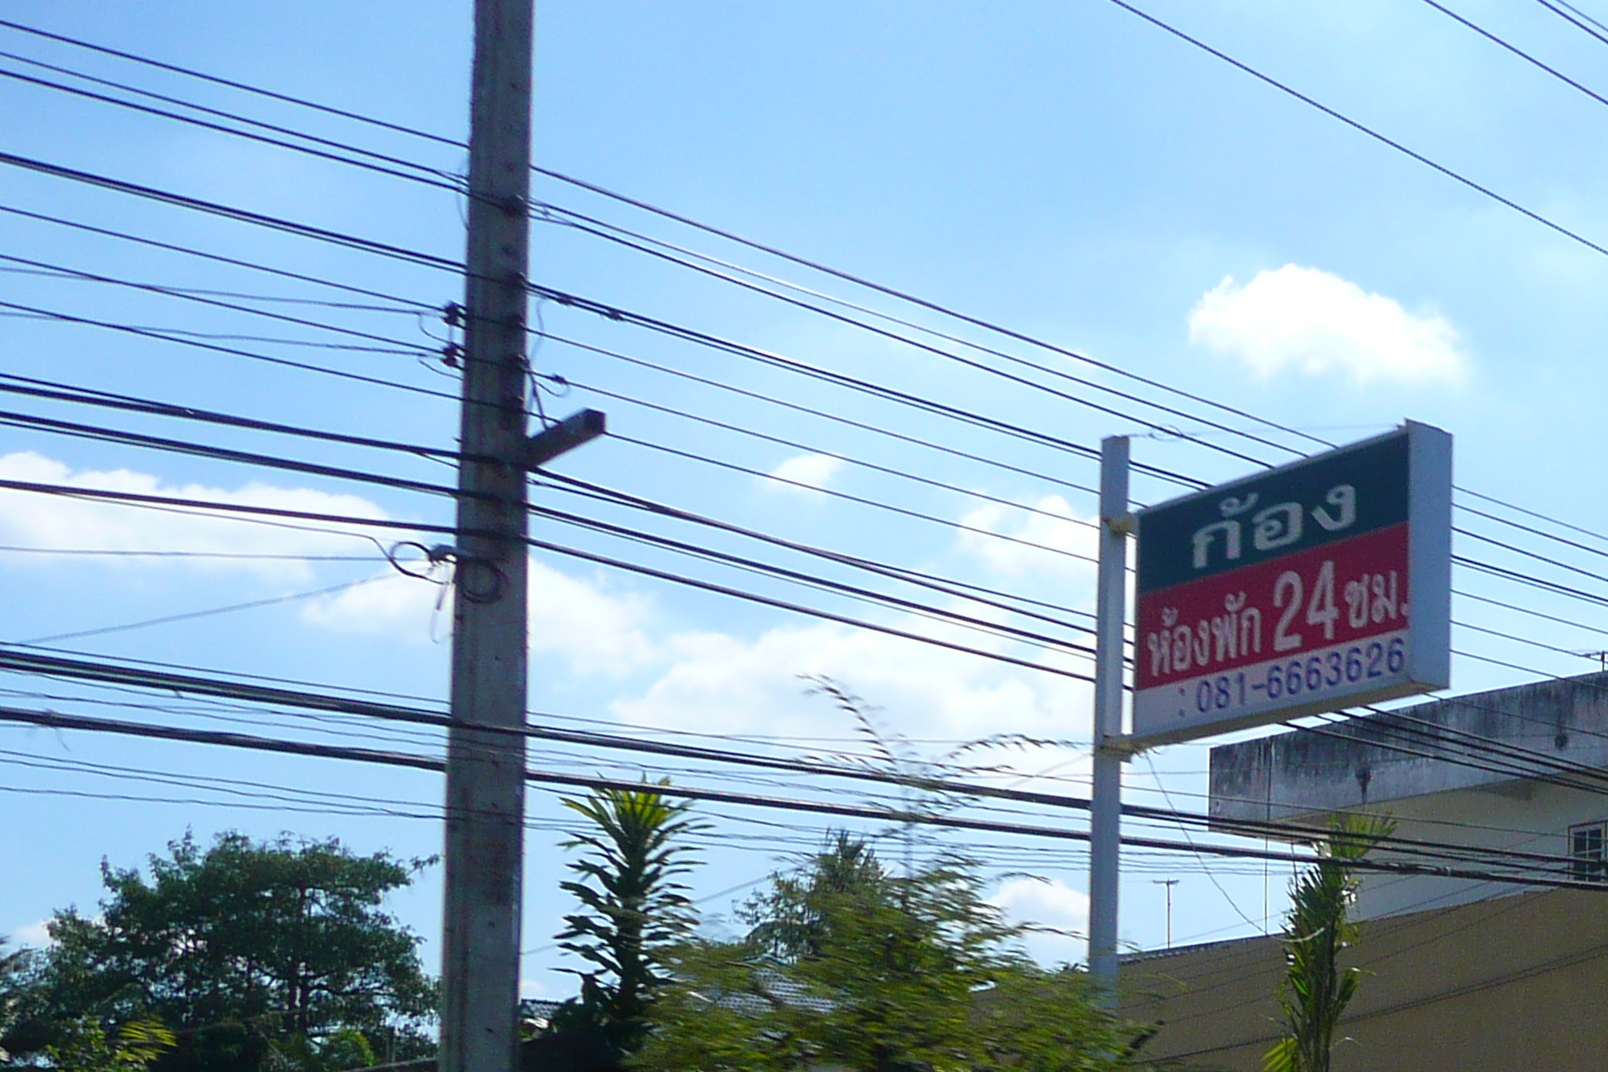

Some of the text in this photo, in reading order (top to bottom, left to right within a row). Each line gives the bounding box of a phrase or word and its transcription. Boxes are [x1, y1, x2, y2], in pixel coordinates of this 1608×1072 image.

[1191, 482, 1358, 570] ก้อง
[1147, 590, 1262, 678] ห้องพัก
[1273, 560, 1340, 652] 24
[1196, 637, 1405, 714] 081-6663626
